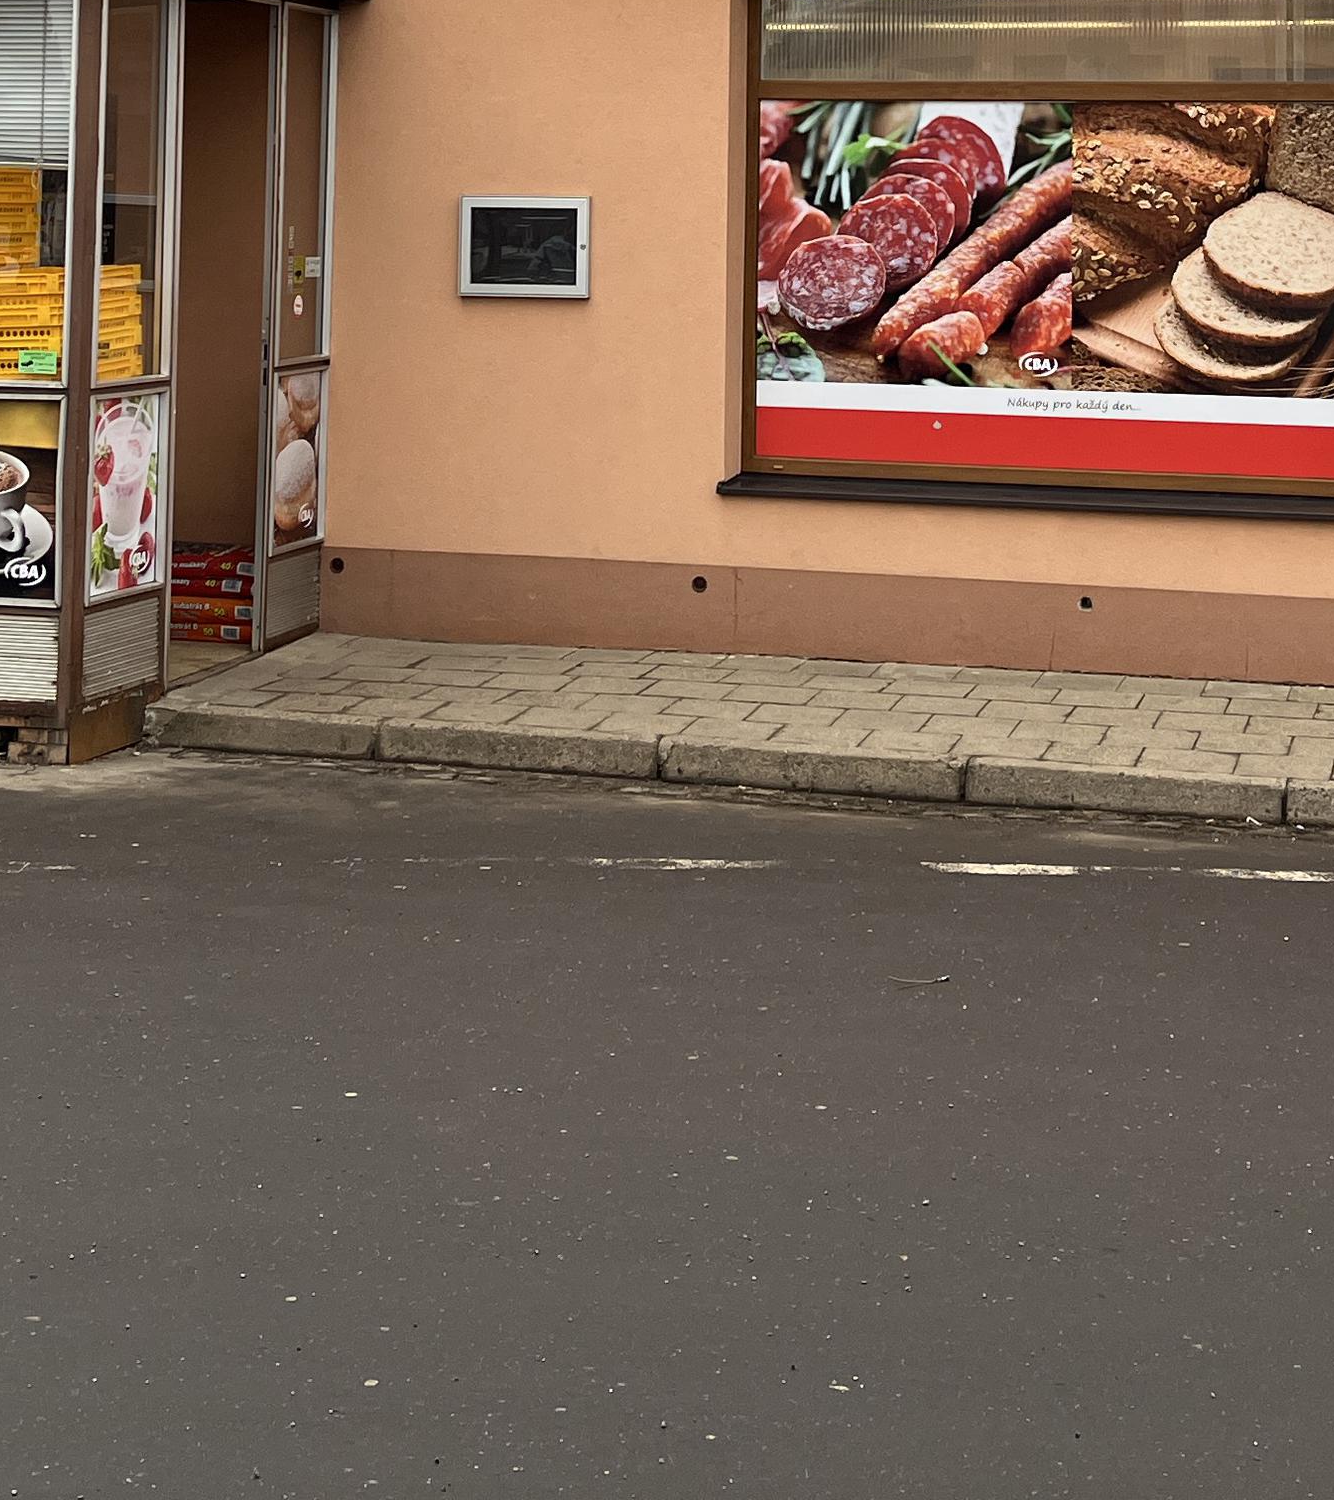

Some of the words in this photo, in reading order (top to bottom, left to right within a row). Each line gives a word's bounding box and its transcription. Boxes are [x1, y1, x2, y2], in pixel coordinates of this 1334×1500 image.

[1024, 357, 1052, 371] CBA
[1007, 398, 1049, 411] Nákupy
[1053, 401, 1072, 411] pro
[1076, 399, 1108, 413] každý
[10, 562, 38, 578] CBA
